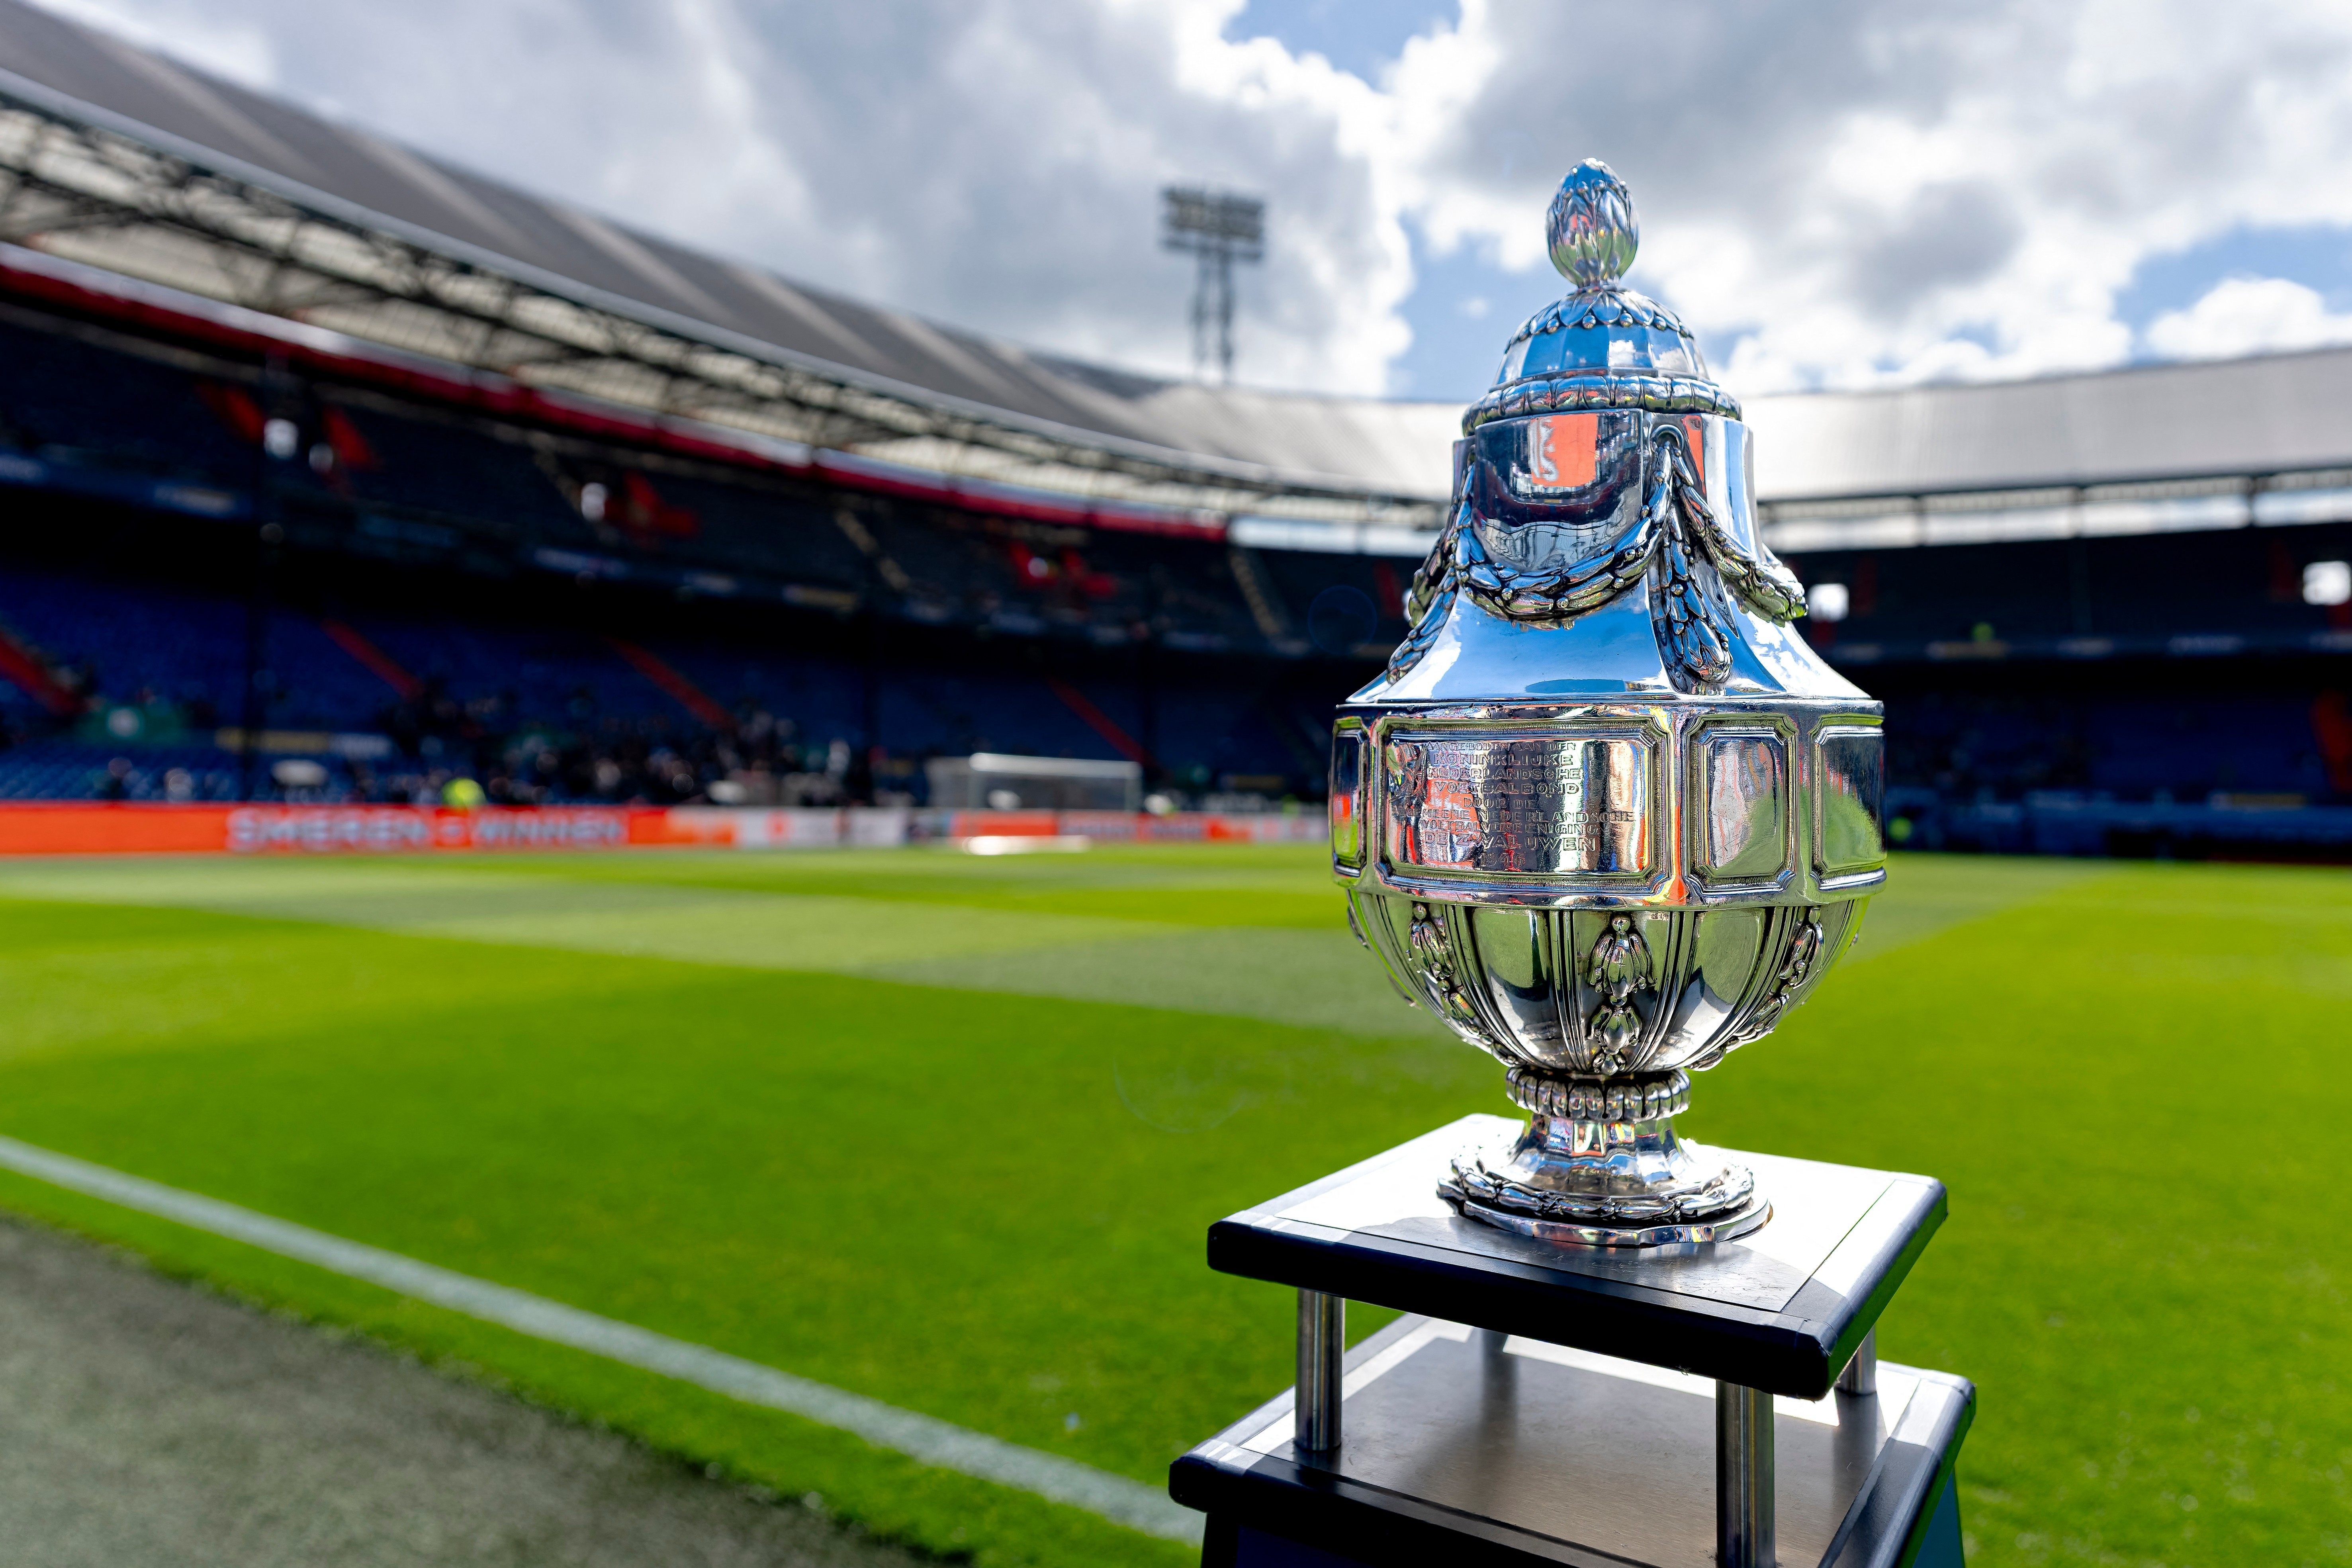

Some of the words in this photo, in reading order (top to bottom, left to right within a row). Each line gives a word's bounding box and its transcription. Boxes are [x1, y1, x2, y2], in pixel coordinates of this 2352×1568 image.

[1427, 742, 1510, 751] AANGEBODEN
[1514, 742, 1541, 751] AAN
[1547, 742, 1576, 751] DEN
[1433, 753, 1573, 766] KONINKLIJKE
[1427, 767, 1583, 780] NEDERLANDSCHE
[1434, 782, 1579, 795] VOETBALBOND
[1464, 797, 1507, 809] DOOR
[1513, 799, 1535, 809] DE
[1478, 809, 1634, 824] NEDERLANDSCHE
[1425, 831, 1448, 846] DE
[1456, 832, 1596, 851] ZWALUWEN
[1479, 852, 1526, 867] 1946
